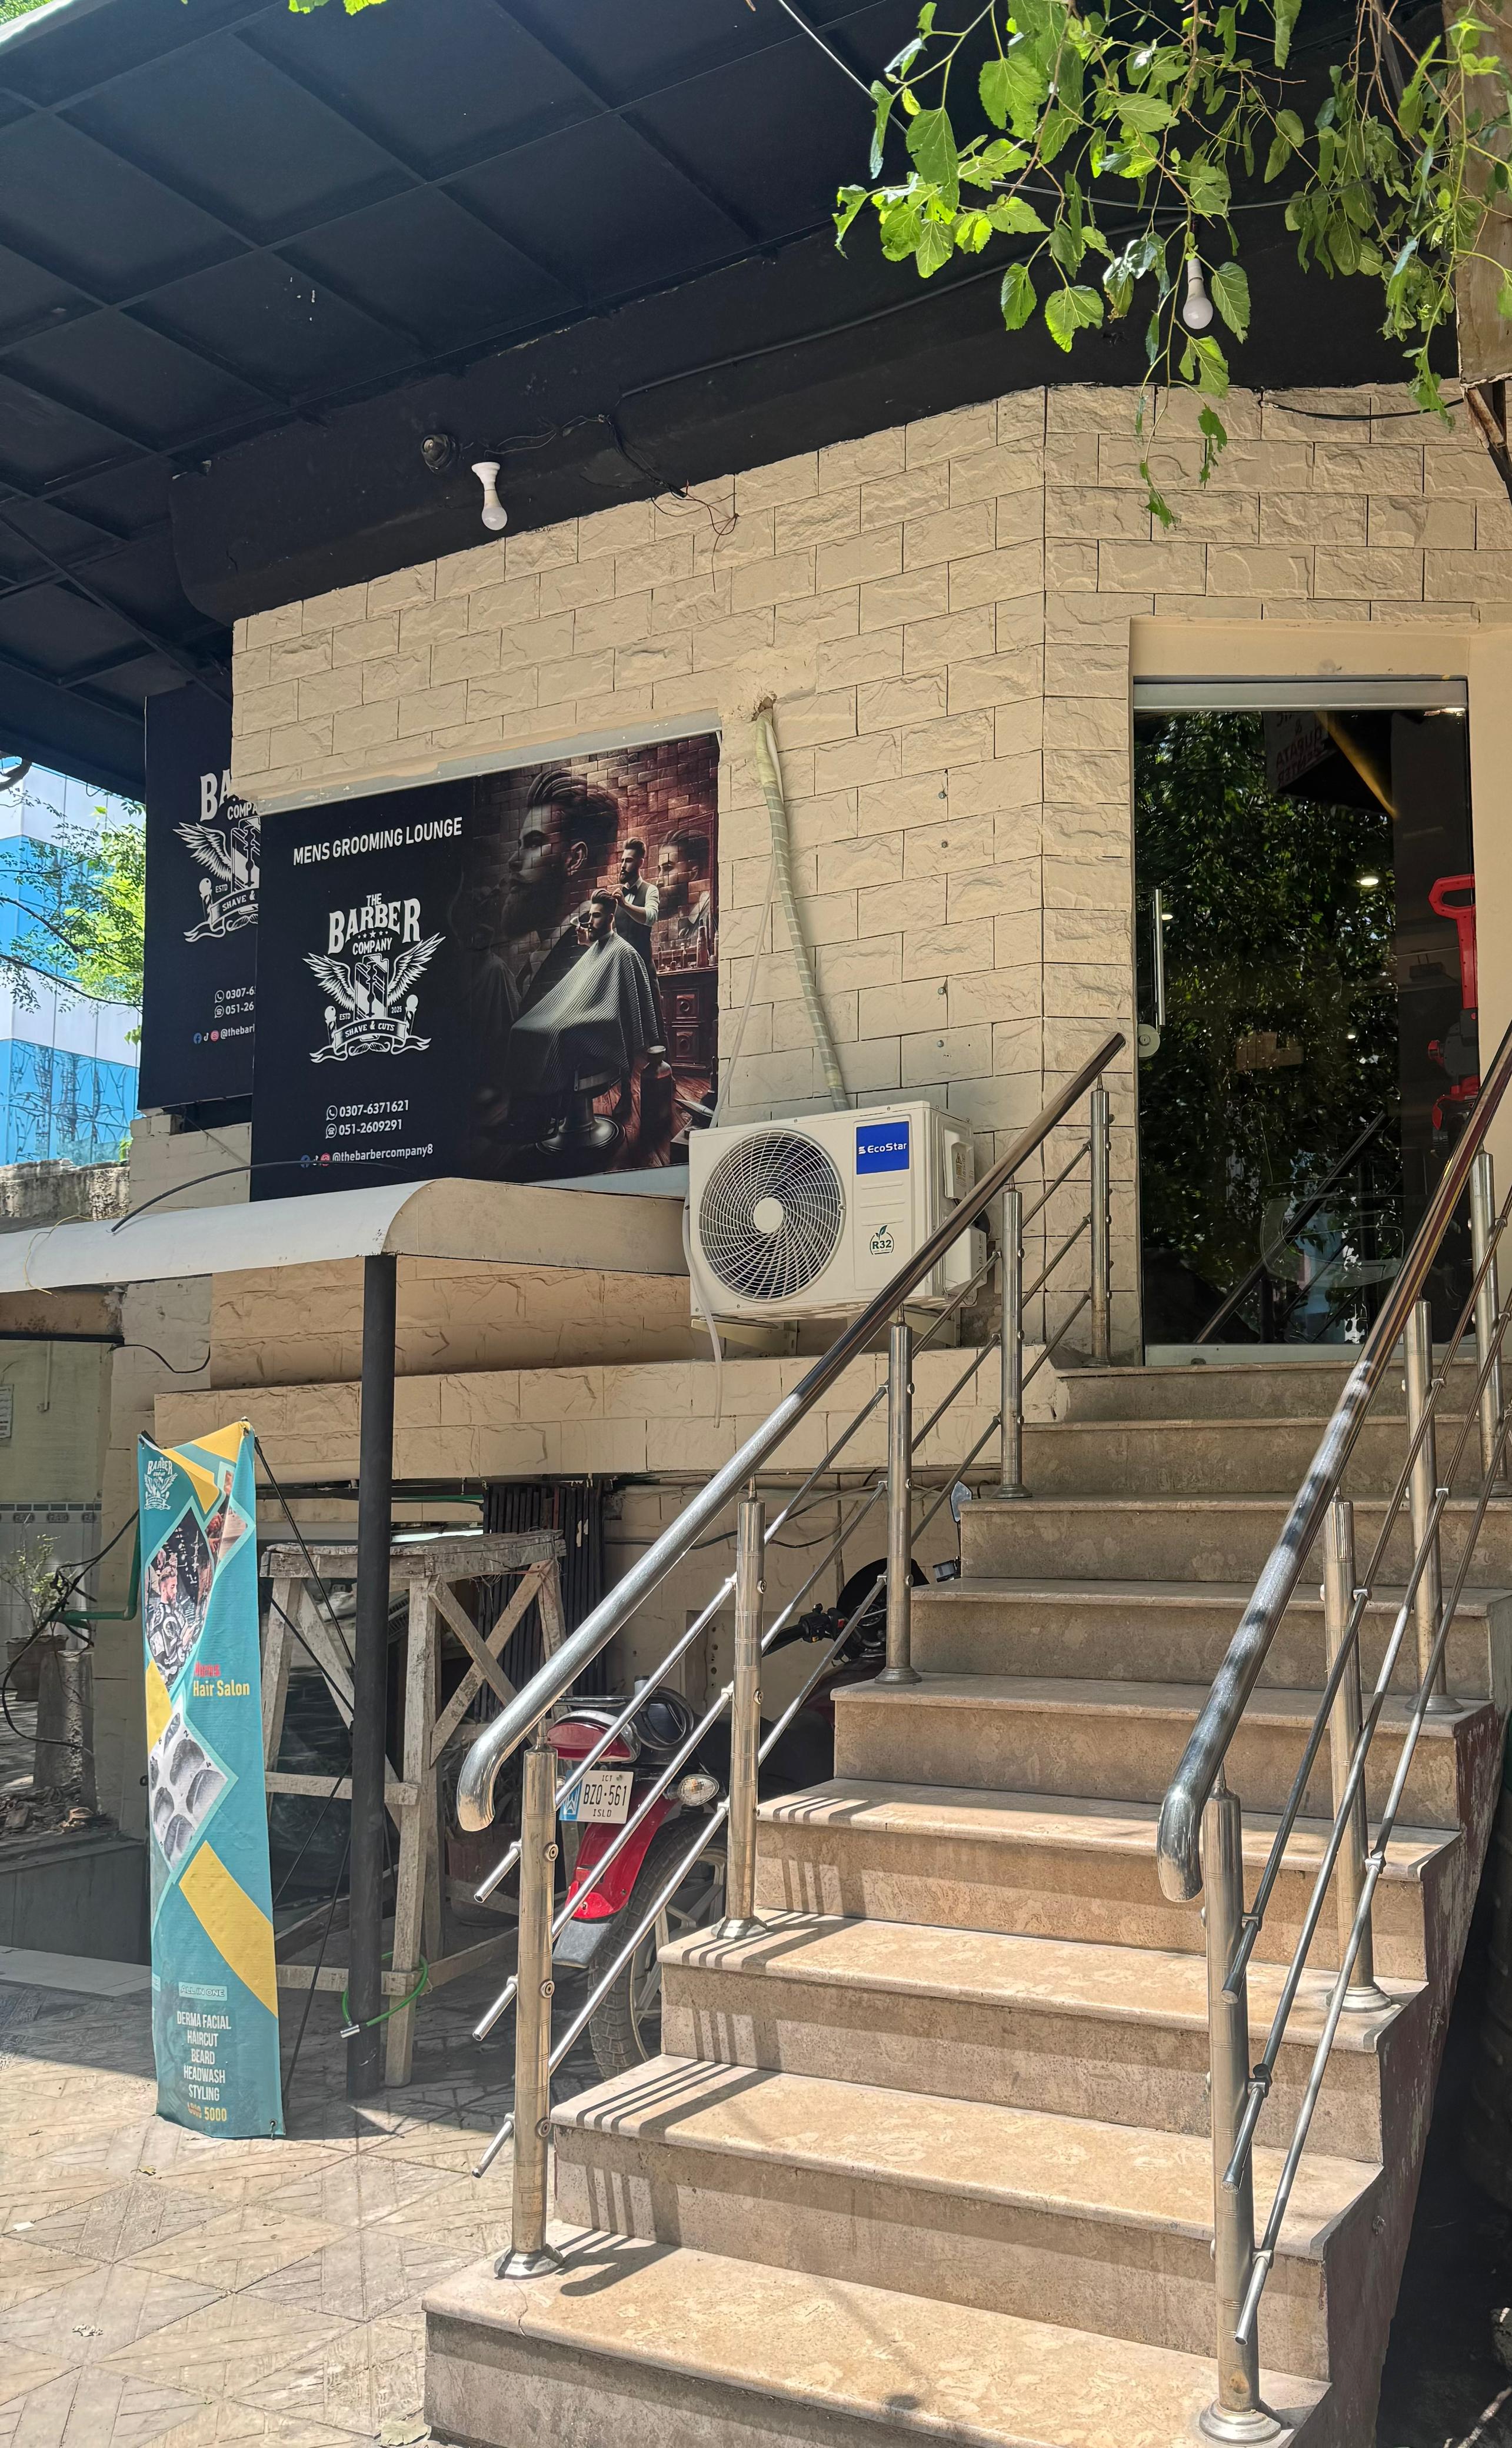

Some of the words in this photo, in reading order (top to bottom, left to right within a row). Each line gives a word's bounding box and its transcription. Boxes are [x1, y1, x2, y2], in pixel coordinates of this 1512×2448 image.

[293, 842, 330, 866] MENS
[332, 828, 403, 858] GROOMING
[406, 817, 462, 844] LOUNGE
[215, 884, 228, 893] ESTD
[222, 894, 247, 912] SHAVE
[366, 893, 382, 906] THE
[328, 898, 421, 954] BARBER
[352, 937, 392, 955] COMPANY
[225, 986, 256, 1000] 0307-6
[345, 1024, 367, 1037] SHAVE
[370, 1020, 375, 1030] &
[378, 1023, 395, 1032] CUTS
[339, 1100, 409, 1117] 0307-6371621
[339, 1119, 402, 1136] 051-2609291
[332, 1143, 433, 1164] @thebarbercompany8
[867, 1142, 907, 1153] EcoStar
[872, 1240, 892, 1249] R32
[193, 1680, 214, 1697] Hair
[217, 1679, 250, 1697] Salon
[593, 1809, 612, 1817] ISLD
[181, 1985, 197, 1994] ALL
[206, 1989, 225, 1997] ONE
[176, 2010, 201, 2027] DERMA
[202, 2014, 232, 2030] FACIAL
[187, 2030, 219, 2047] HAIRCUT
[191, 2048, 215, 2065] BEARD
[184, 2064, 226, 2084] HEADWASH
[188, 2084, 220, 2101] STYLING
[205, 2107, 227, 2121] 5000
